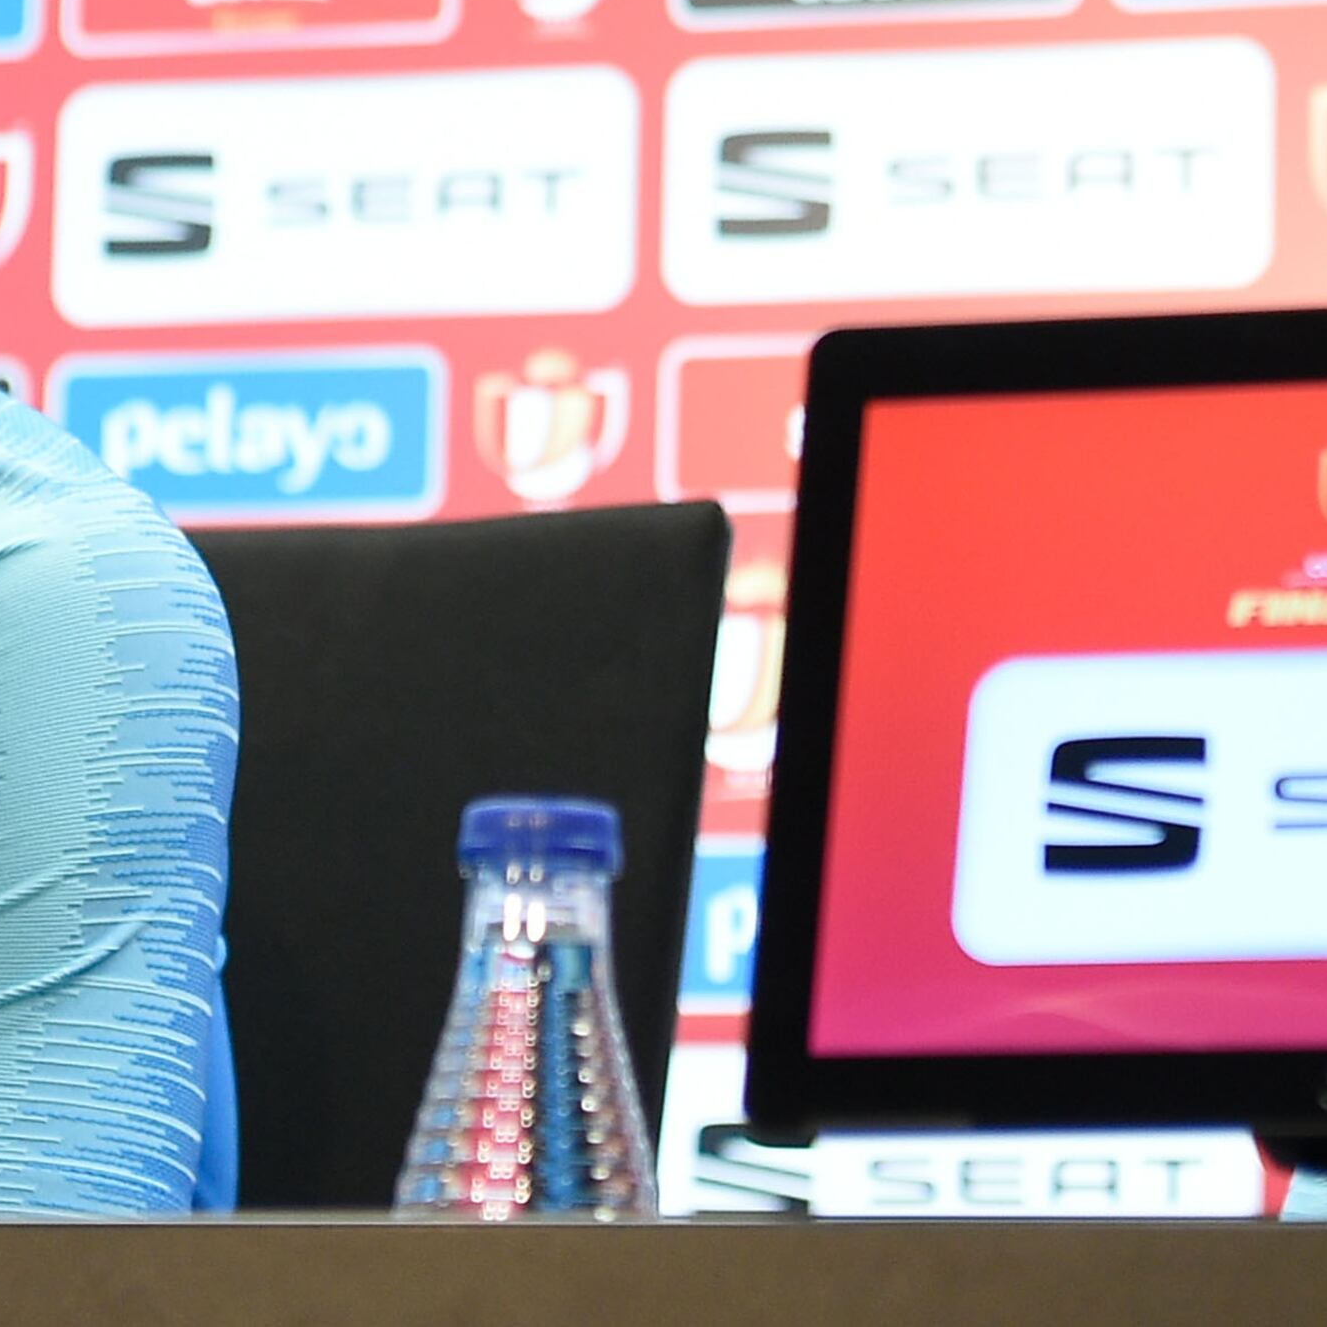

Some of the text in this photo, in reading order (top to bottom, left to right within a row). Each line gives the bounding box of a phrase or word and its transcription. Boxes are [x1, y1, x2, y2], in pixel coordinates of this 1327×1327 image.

[262, 167, 585, 230] SEAT
[884, 143, 1217, 208] SEAT
[100, 382, 391, 493] pelayo
[867, 1156, 1204, 1207] SEAT
